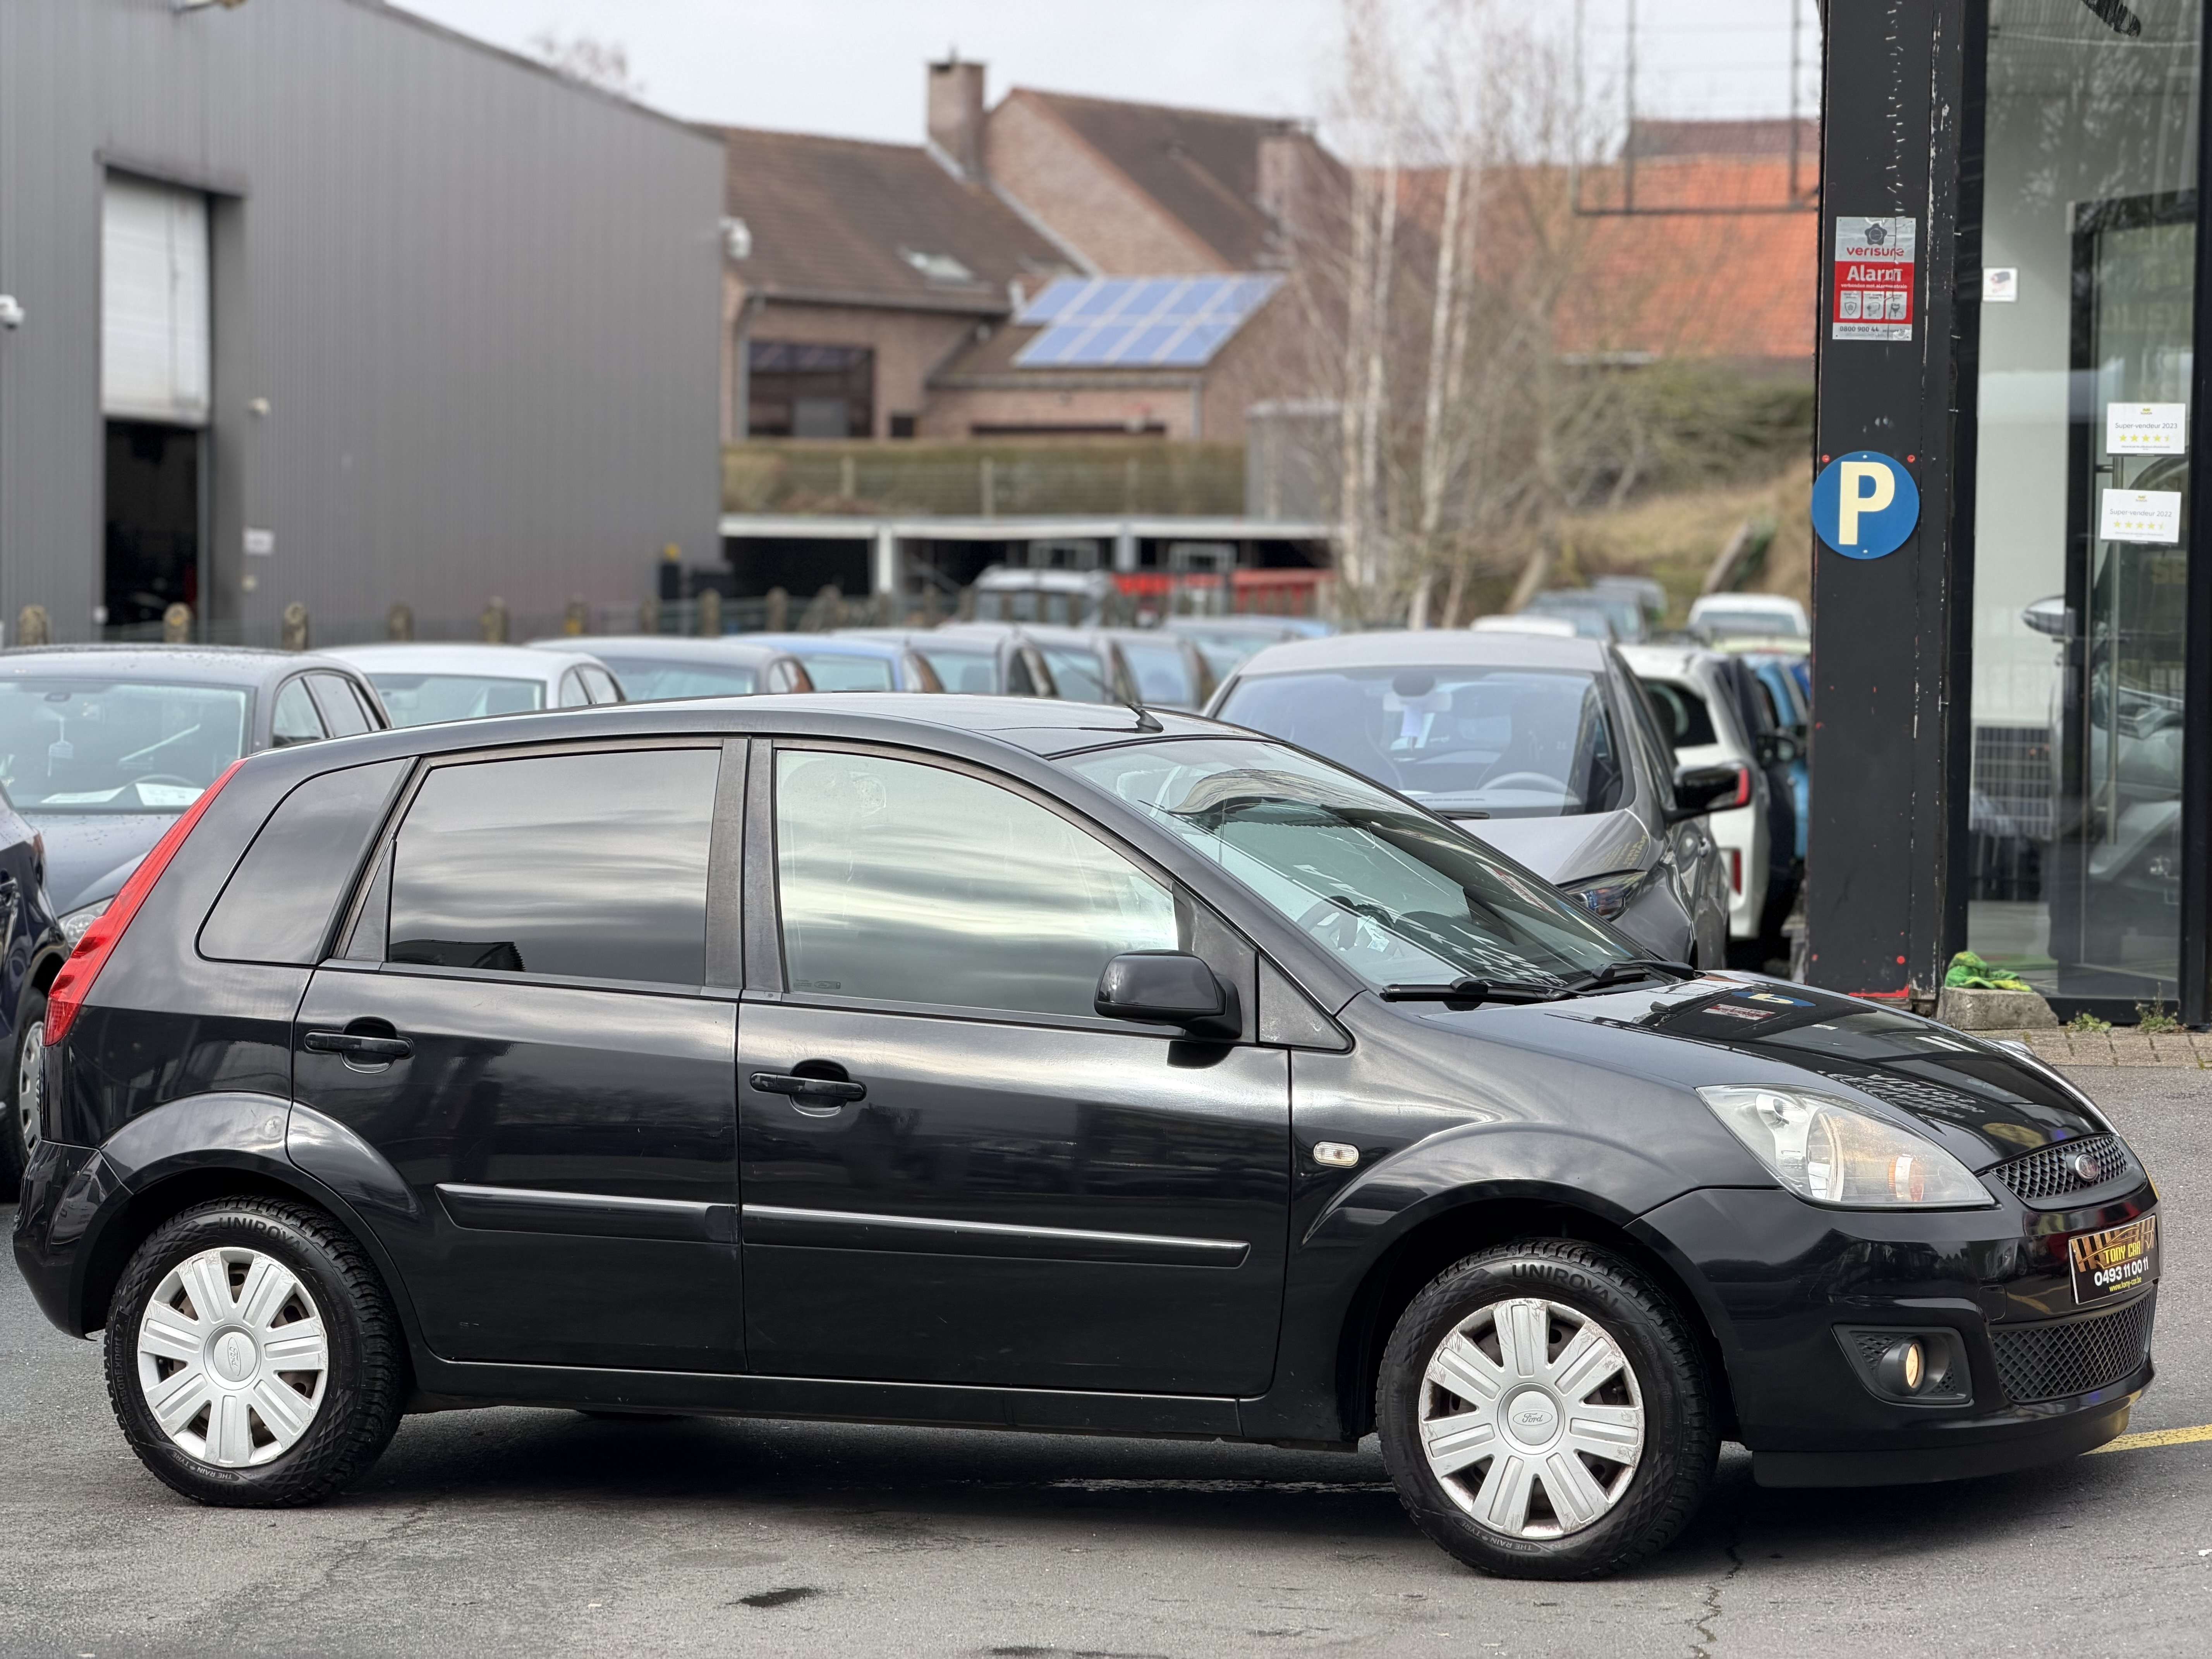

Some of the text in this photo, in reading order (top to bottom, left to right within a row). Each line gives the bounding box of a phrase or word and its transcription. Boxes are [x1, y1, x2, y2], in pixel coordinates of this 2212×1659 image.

[1846, 247, 1904, 256] verisure
[1846, 265, 1903, 282] Alarm
[1839, 462, 1895, 544] P
[2103, 1241, 2141, 1264] TONY CAR
[2094, 1256, 2149, 1286] 0493 11 00 11
[2109, 1275, 2142, 1292] www.tony-car.be
[229, 1346, 239, 1367] Ford
[1522, 1412, 1543, 1423] Ford
[171, 1451, 233, 1480] THE RAIN TYRE
[1460, 1520, 1481, 1537] TYRE
[1490, 1536, 1513, 1548] RAIN
